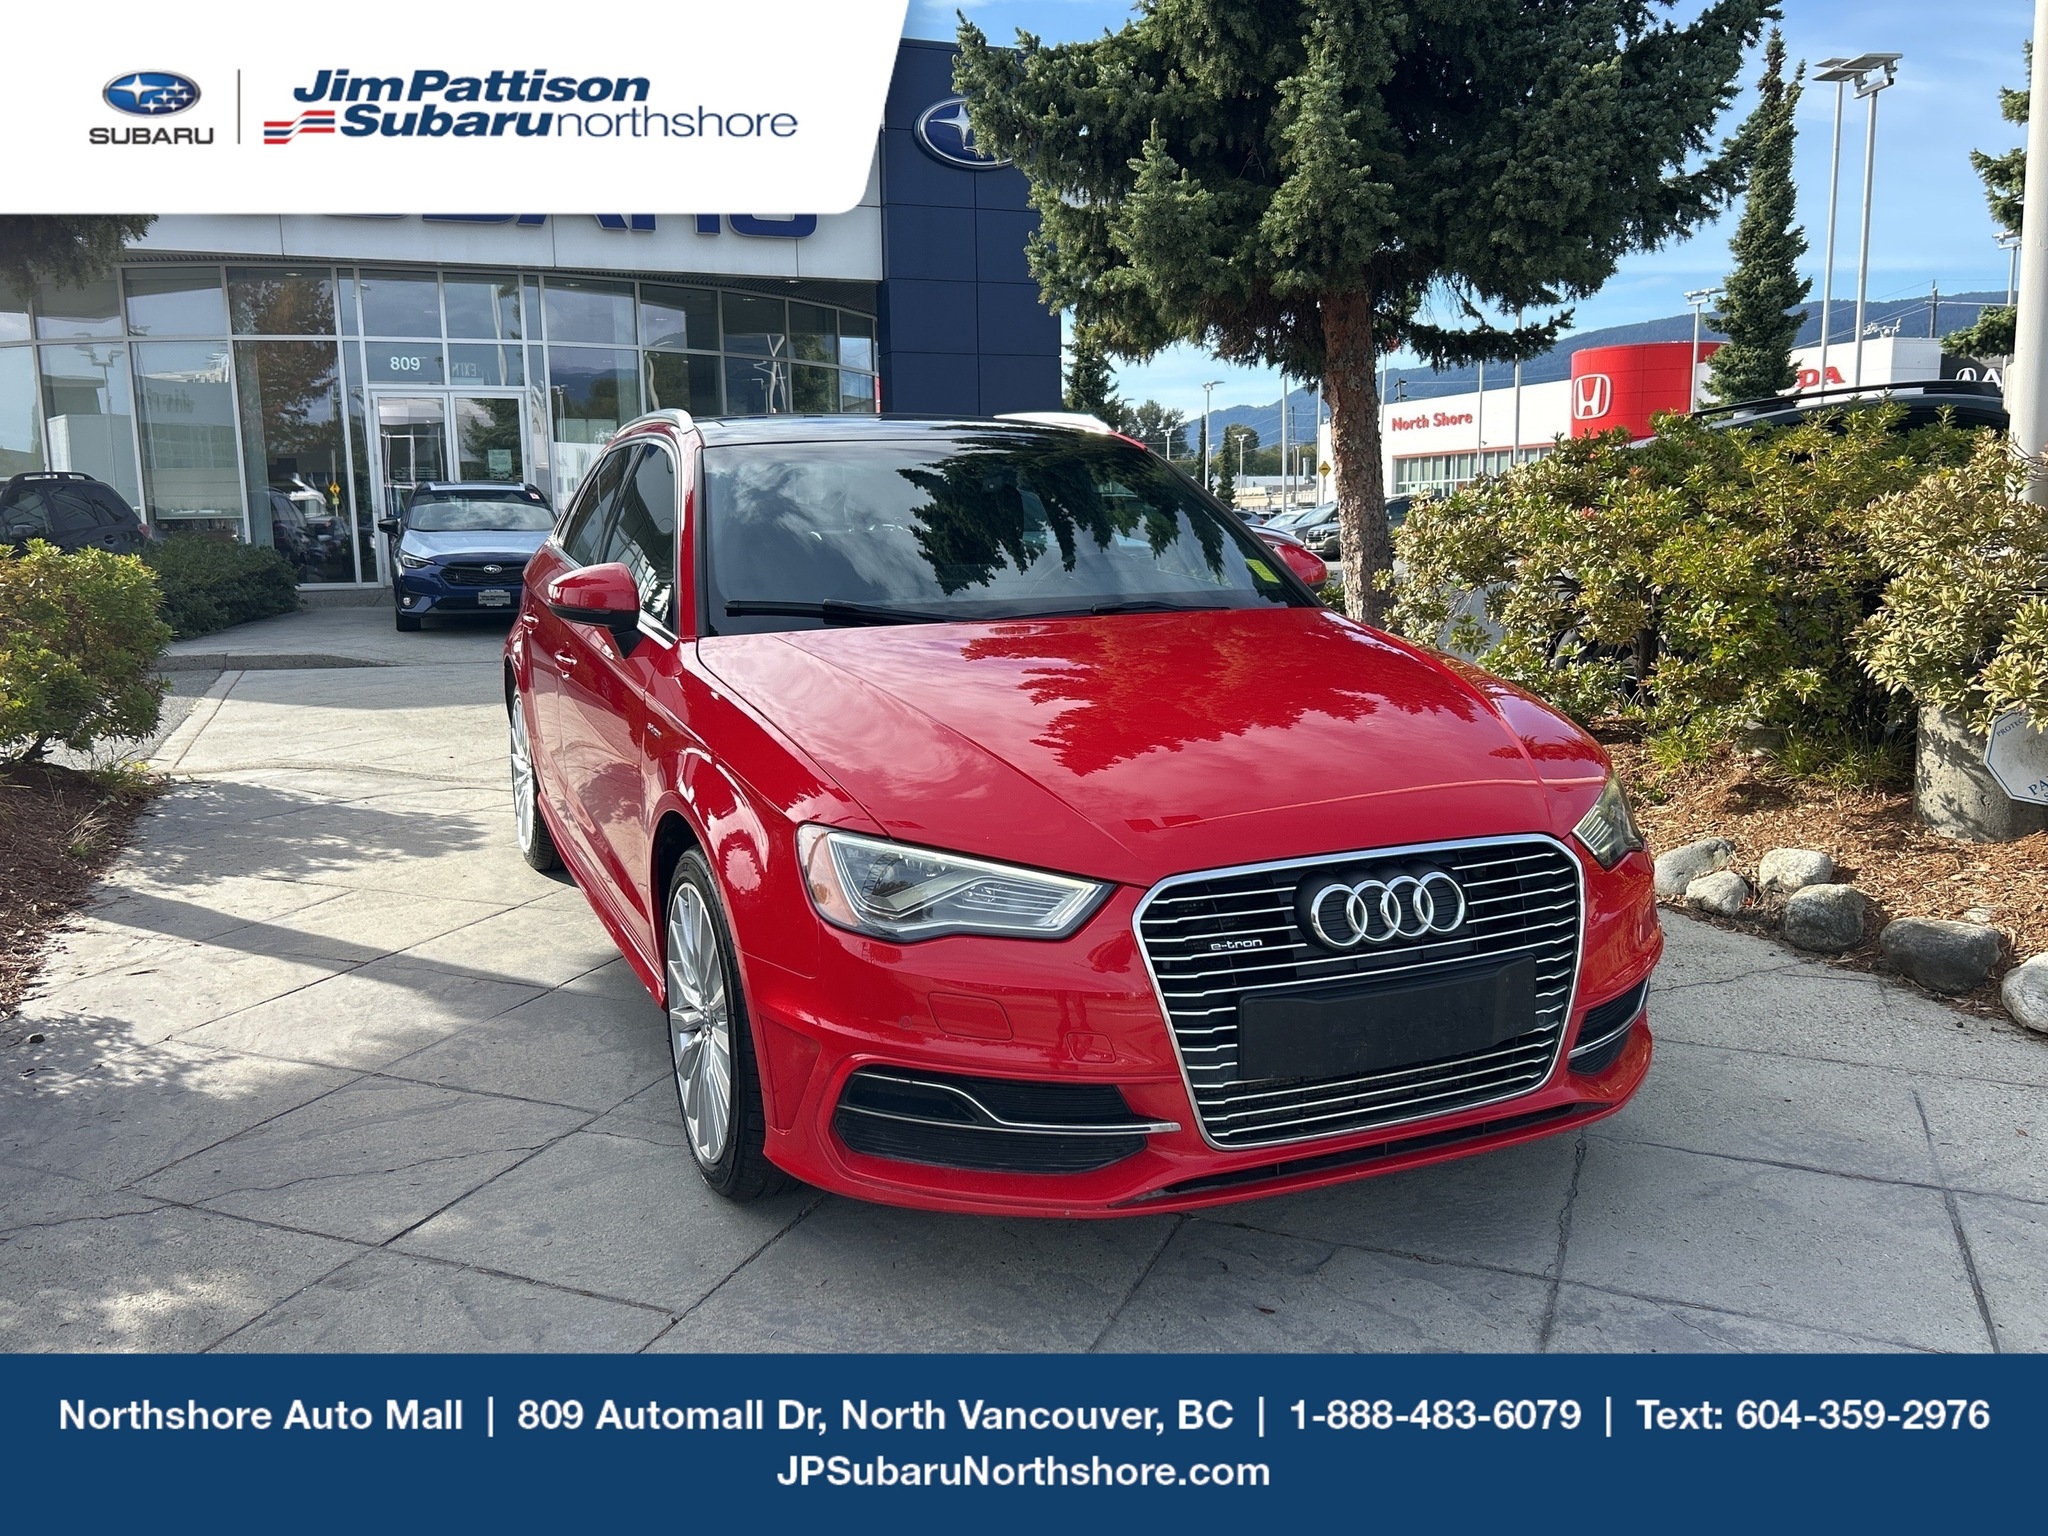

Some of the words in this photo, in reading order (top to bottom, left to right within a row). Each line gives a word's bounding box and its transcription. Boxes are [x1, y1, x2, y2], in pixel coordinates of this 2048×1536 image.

[390, 356, 420, 371] 809
[1391, 414, 1430, 432] North
[1433, 412, 1473, 427] Shore
[1996, 716, 2028, 737] PROTEC
[1210, 939, 1263, 951] e-tron
